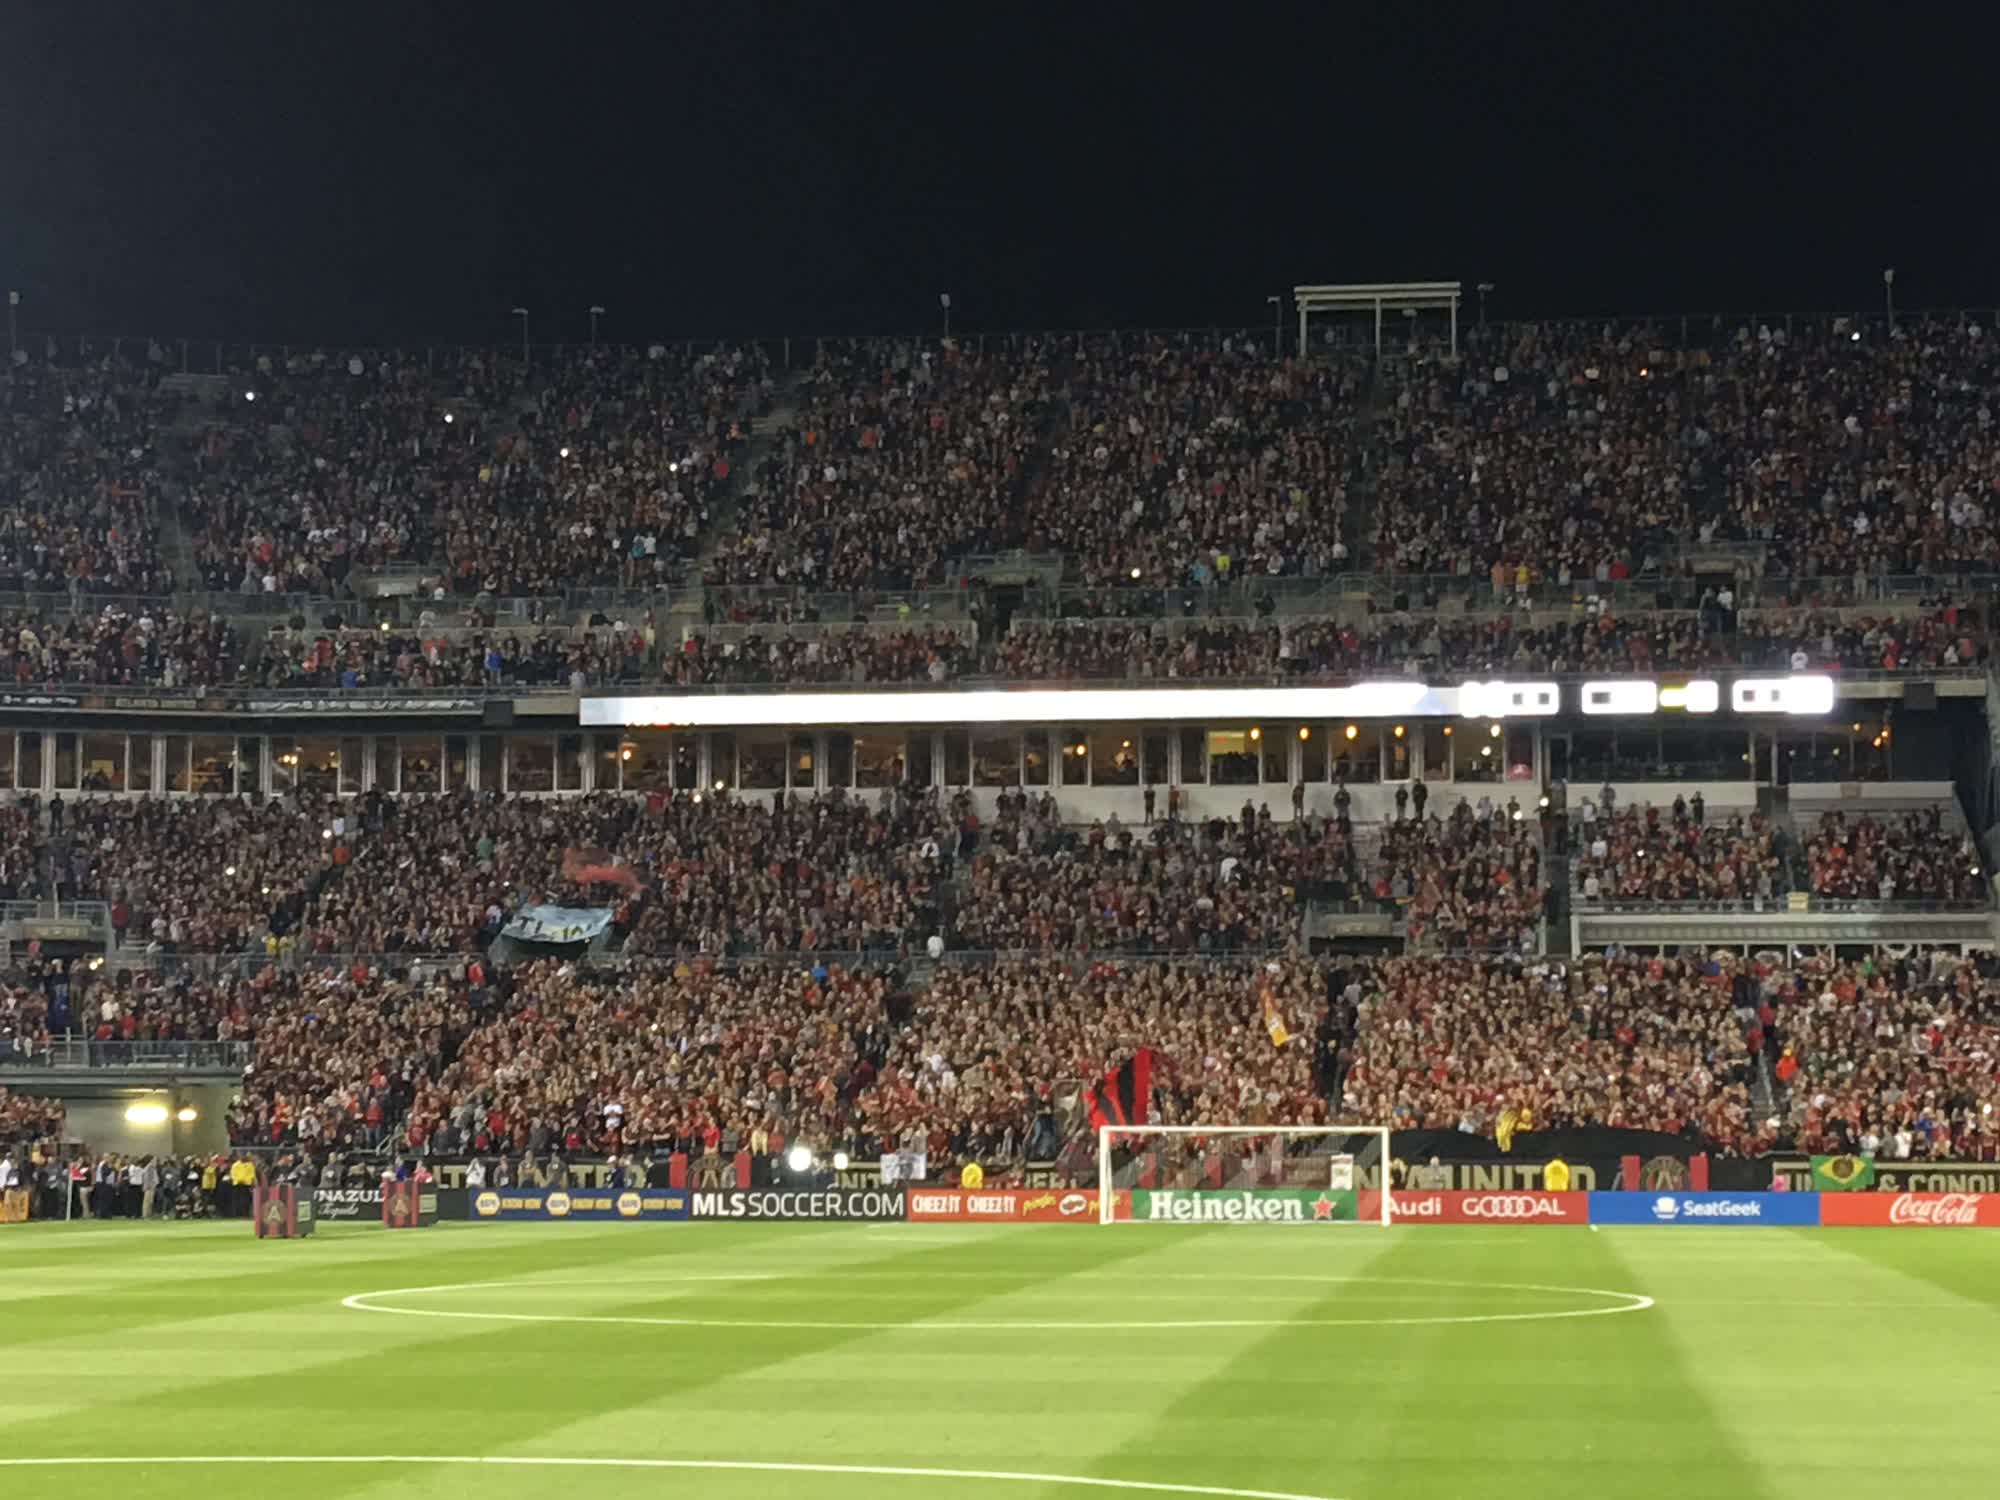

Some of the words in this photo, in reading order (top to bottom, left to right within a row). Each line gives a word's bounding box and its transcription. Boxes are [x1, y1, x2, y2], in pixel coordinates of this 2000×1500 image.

[1149, 1191, 1304, 1220] Heineken
[1388, 1197, 1442, 1216] Audi
[1684, 1199, 1761, 1217] SeatGeek
